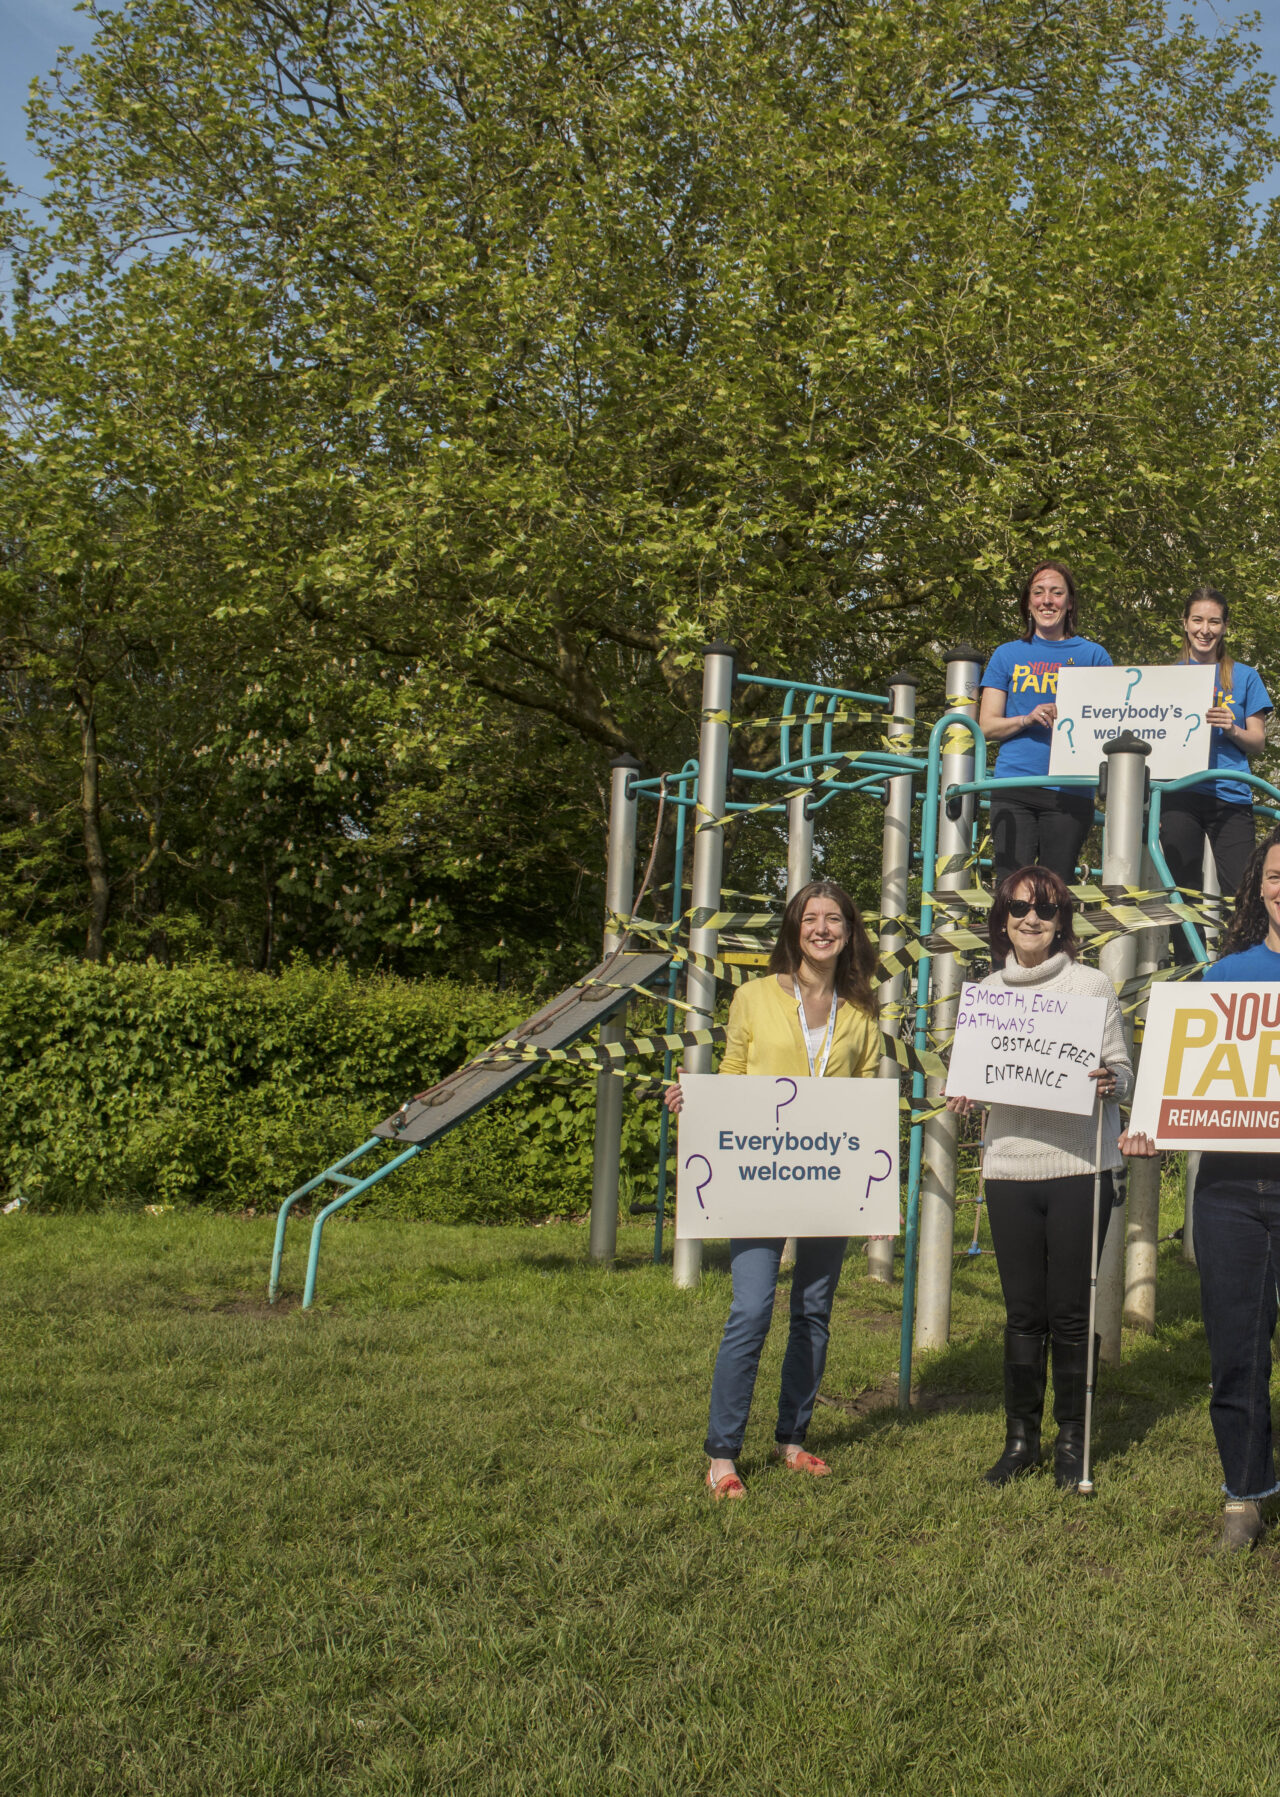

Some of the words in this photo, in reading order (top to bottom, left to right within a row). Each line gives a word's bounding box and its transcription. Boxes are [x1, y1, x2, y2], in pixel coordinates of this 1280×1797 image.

[1012, 664, 1058, 694] PAR
[1094, 726, 1167, 739] welome
[965, 986, 1027, 1013] SMOOTH,
[1031, 994, 1068, 1014] EVEN
[956, 1012, 1035, 1033] PATHWAYS
[991, 1036, 1057, 1055] OBSTACLE
[1058, 1043, 1096, 1067] FREE
[985, 1064, 1068, 1088] ENTRANCE
[1168, 1109, 1280, 1129] REIMAGINING
[738, 1162, 841, 1181] welcome
